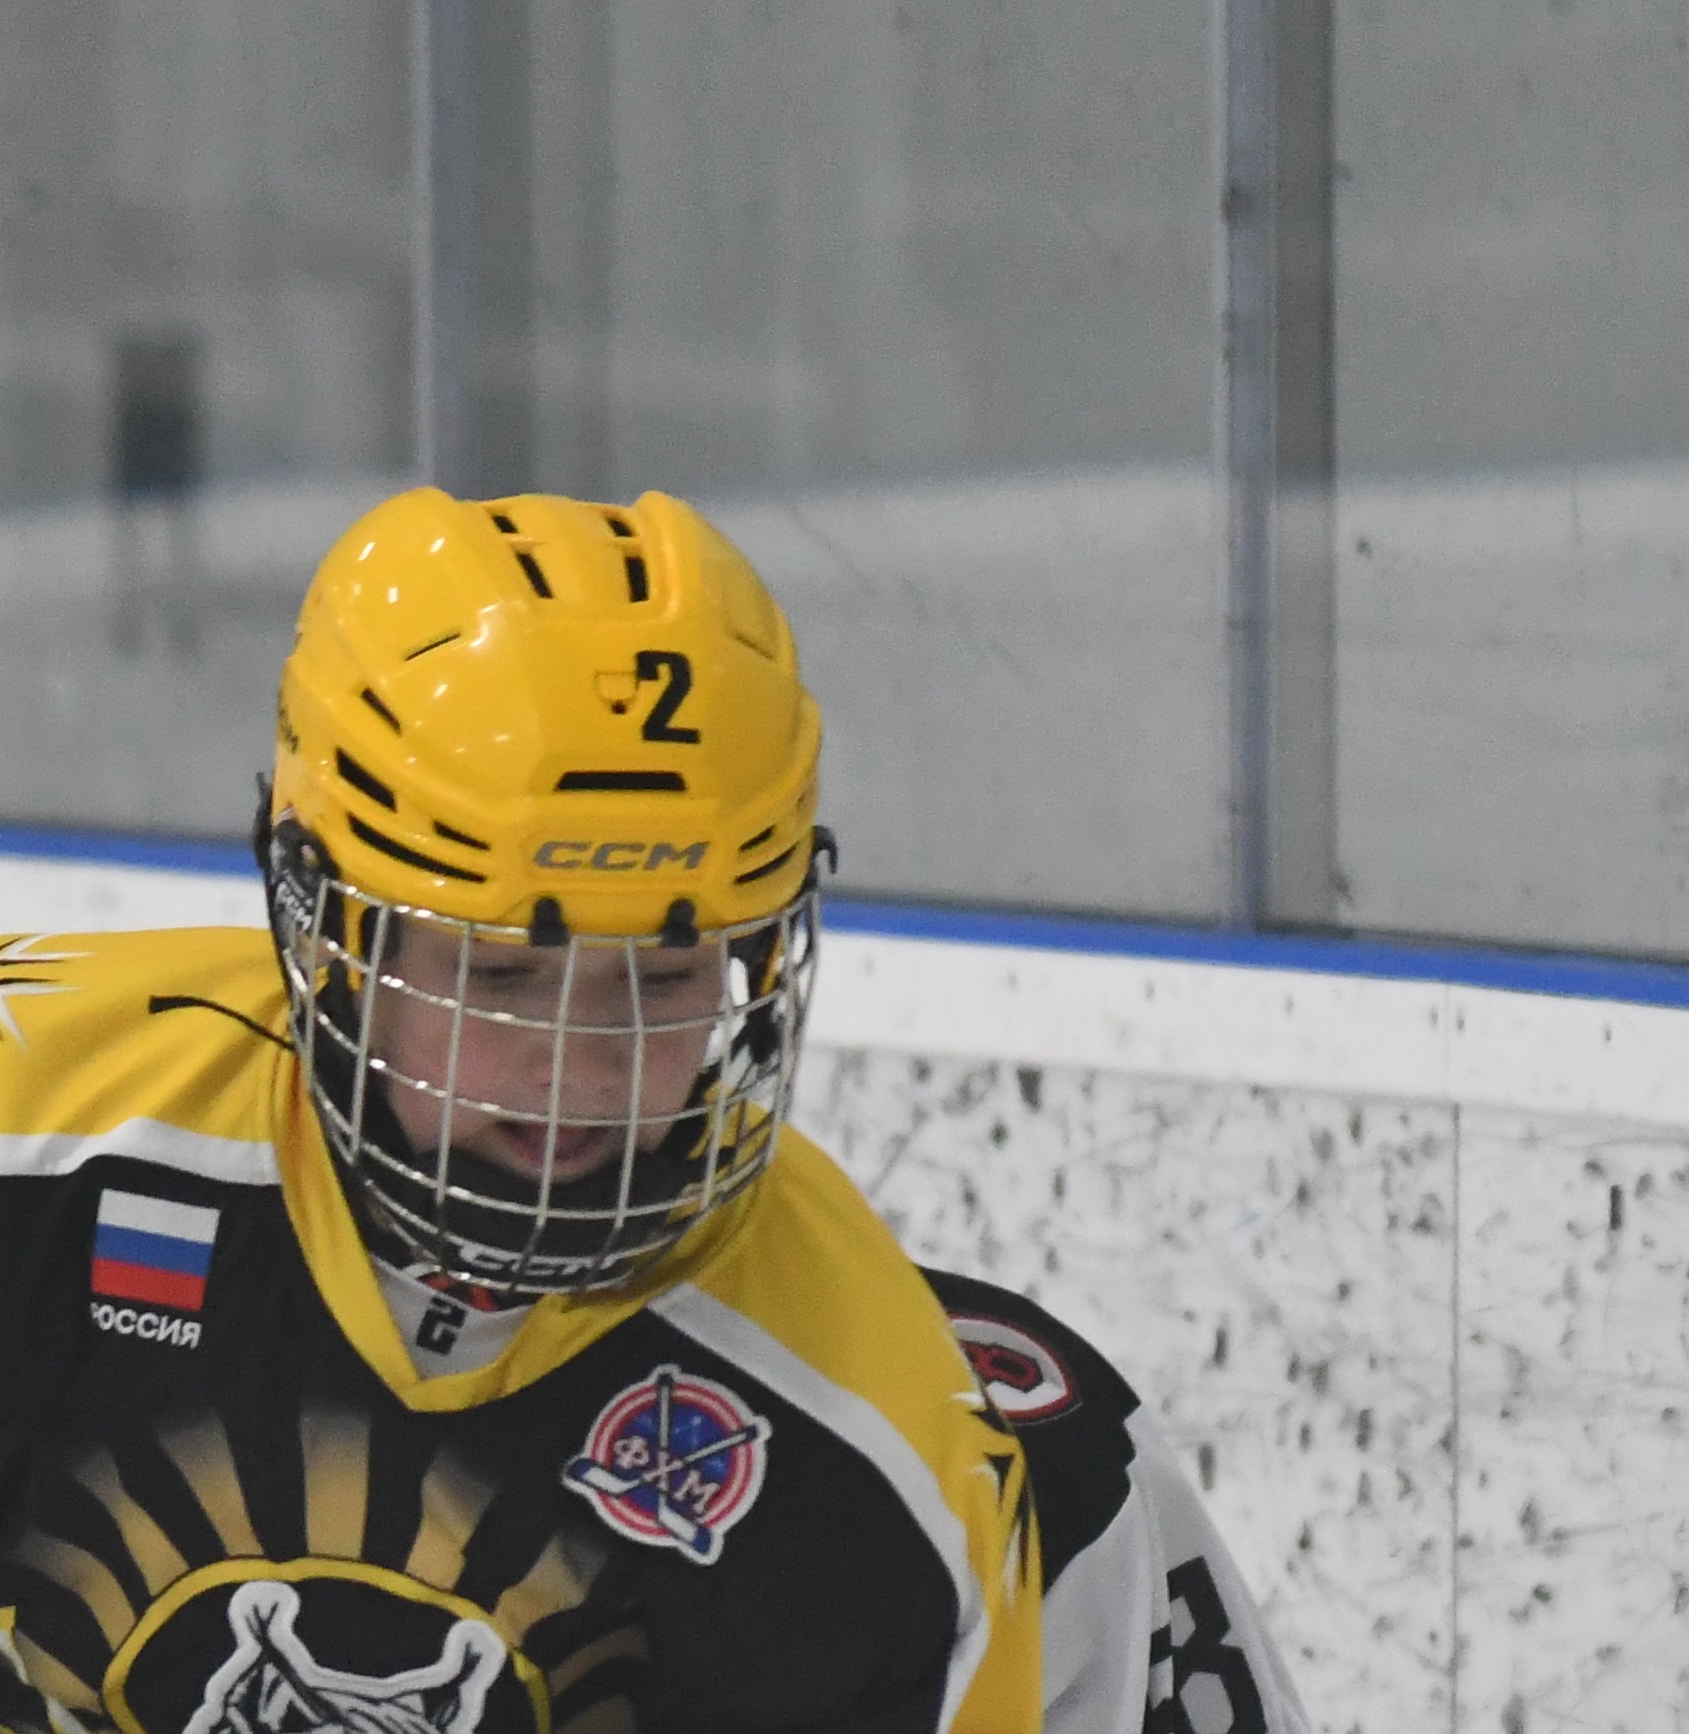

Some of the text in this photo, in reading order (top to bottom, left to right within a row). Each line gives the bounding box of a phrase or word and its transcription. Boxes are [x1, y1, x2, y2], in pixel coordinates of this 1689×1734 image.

[635, 650, 701, 743] 2
[534, 840, 711, 871] CCM
[613, 1434, 720, 1516] ФХМ
